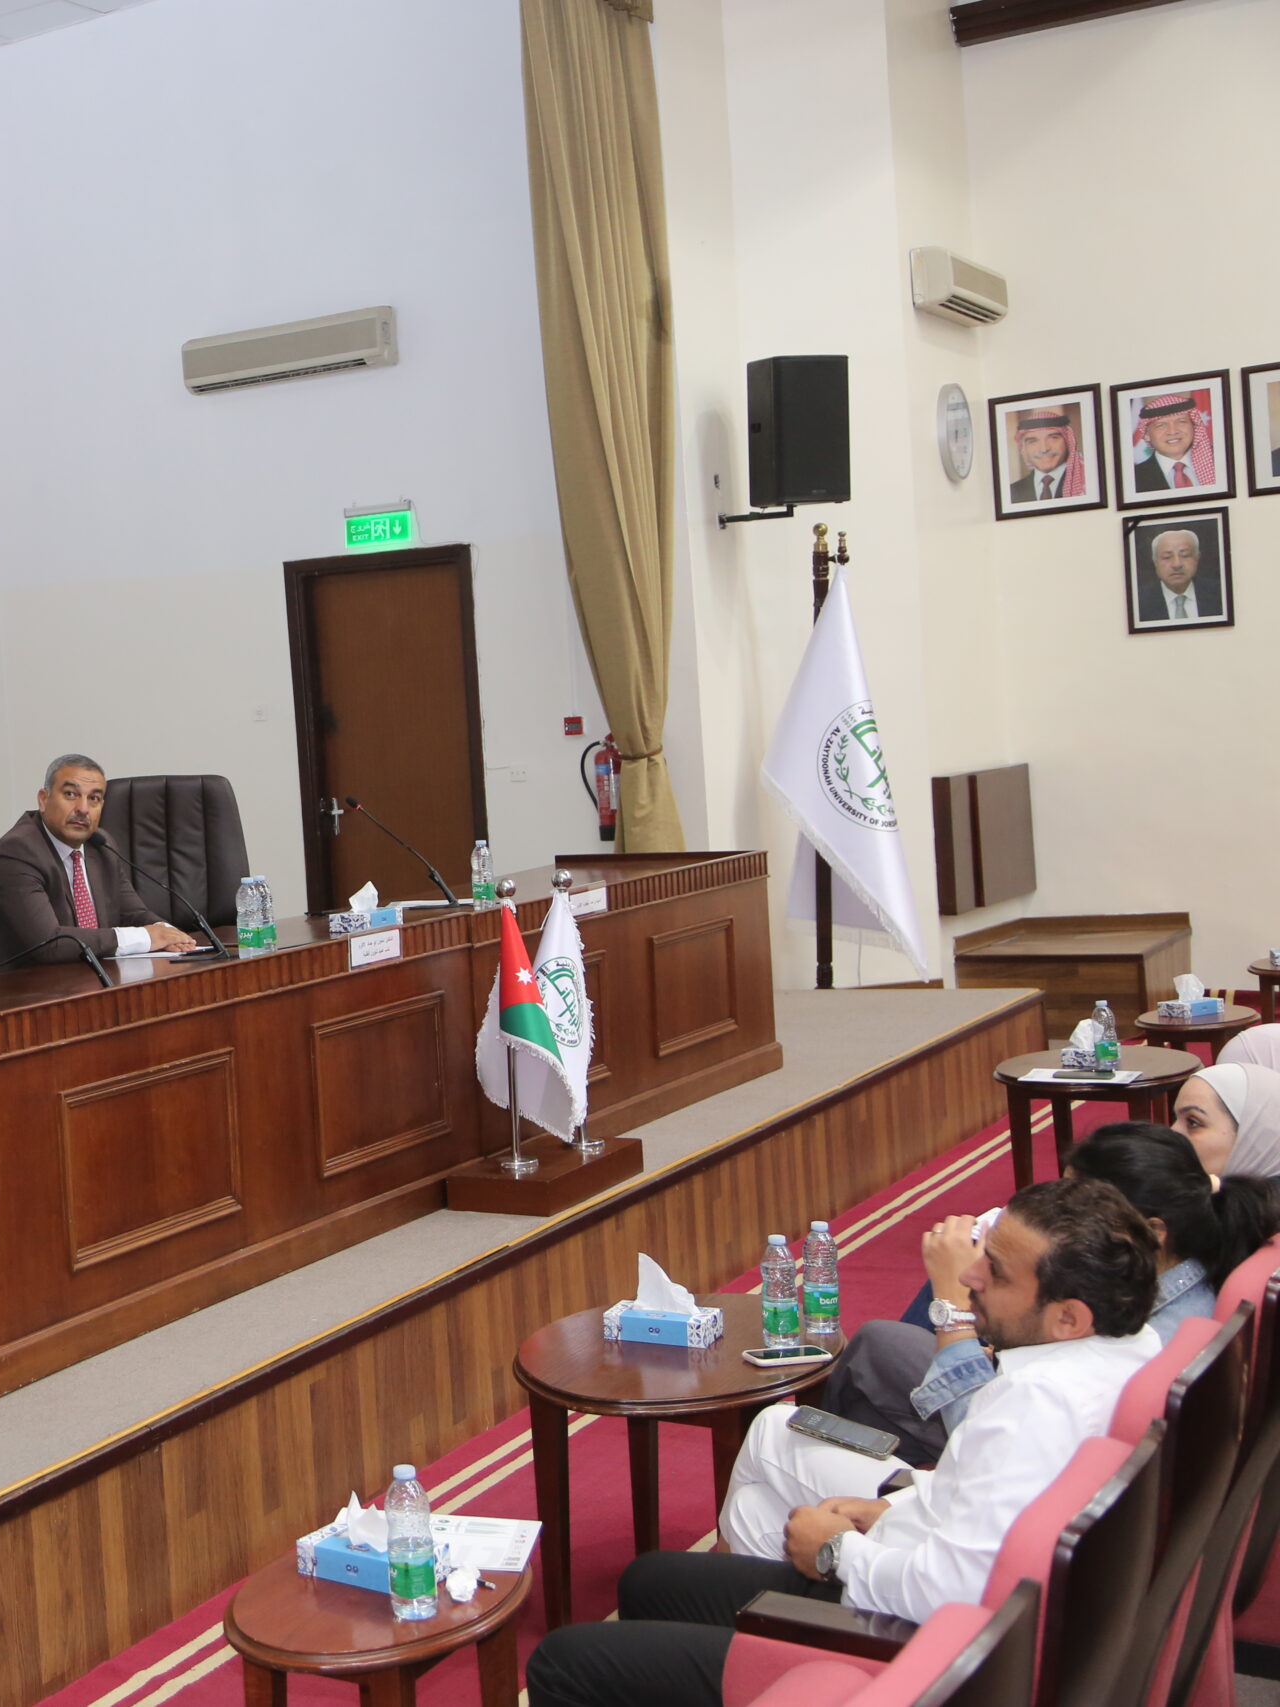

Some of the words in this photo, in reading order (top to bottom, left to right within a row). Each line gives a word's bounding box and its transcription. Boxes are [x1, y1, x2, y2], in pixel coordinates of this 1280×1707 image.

[821, 725, 841, 787] AL-ZAYTOONAH
[829, 786, 868, 822] UNIVERSITY
[869, 817, 879, 825] OF
